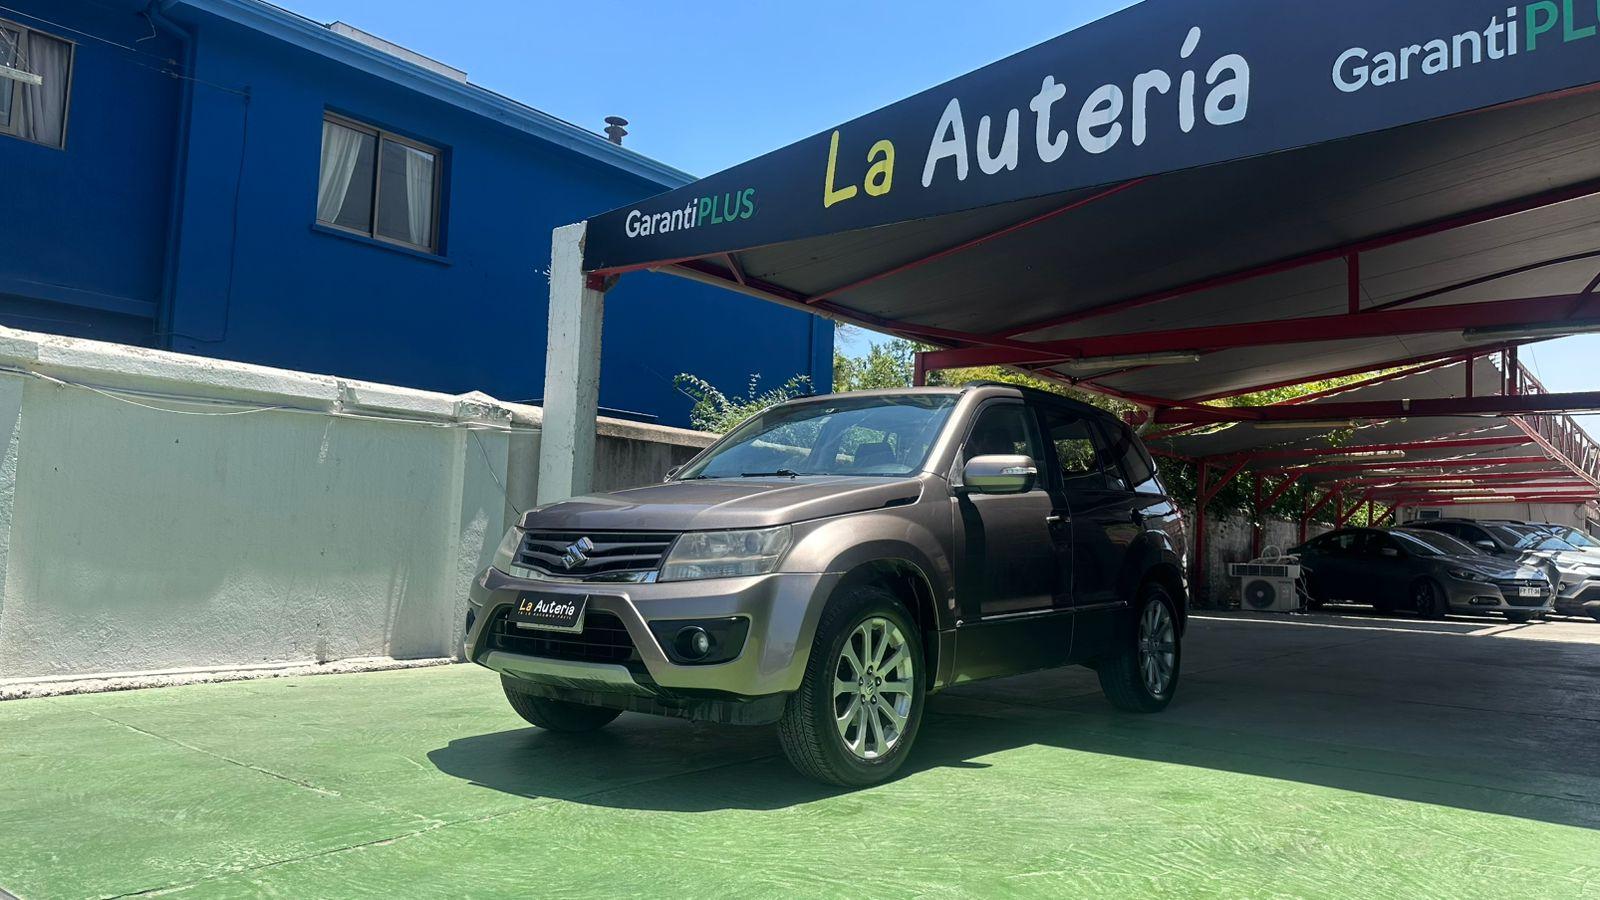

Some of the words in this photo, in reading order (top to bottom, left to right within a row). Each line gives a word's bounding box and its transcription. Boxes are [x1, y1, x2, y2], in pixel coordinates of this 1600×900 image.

[1331, 0, 1600, 93] GarantiPL
[823, 130, 895, 208] La
[921, 26, 1250, 188] Autería
[625, 188, 756, 238] GarantiPLUS
[519, 598, 533, 612] La
[533, 599, 575, 616] Autería
